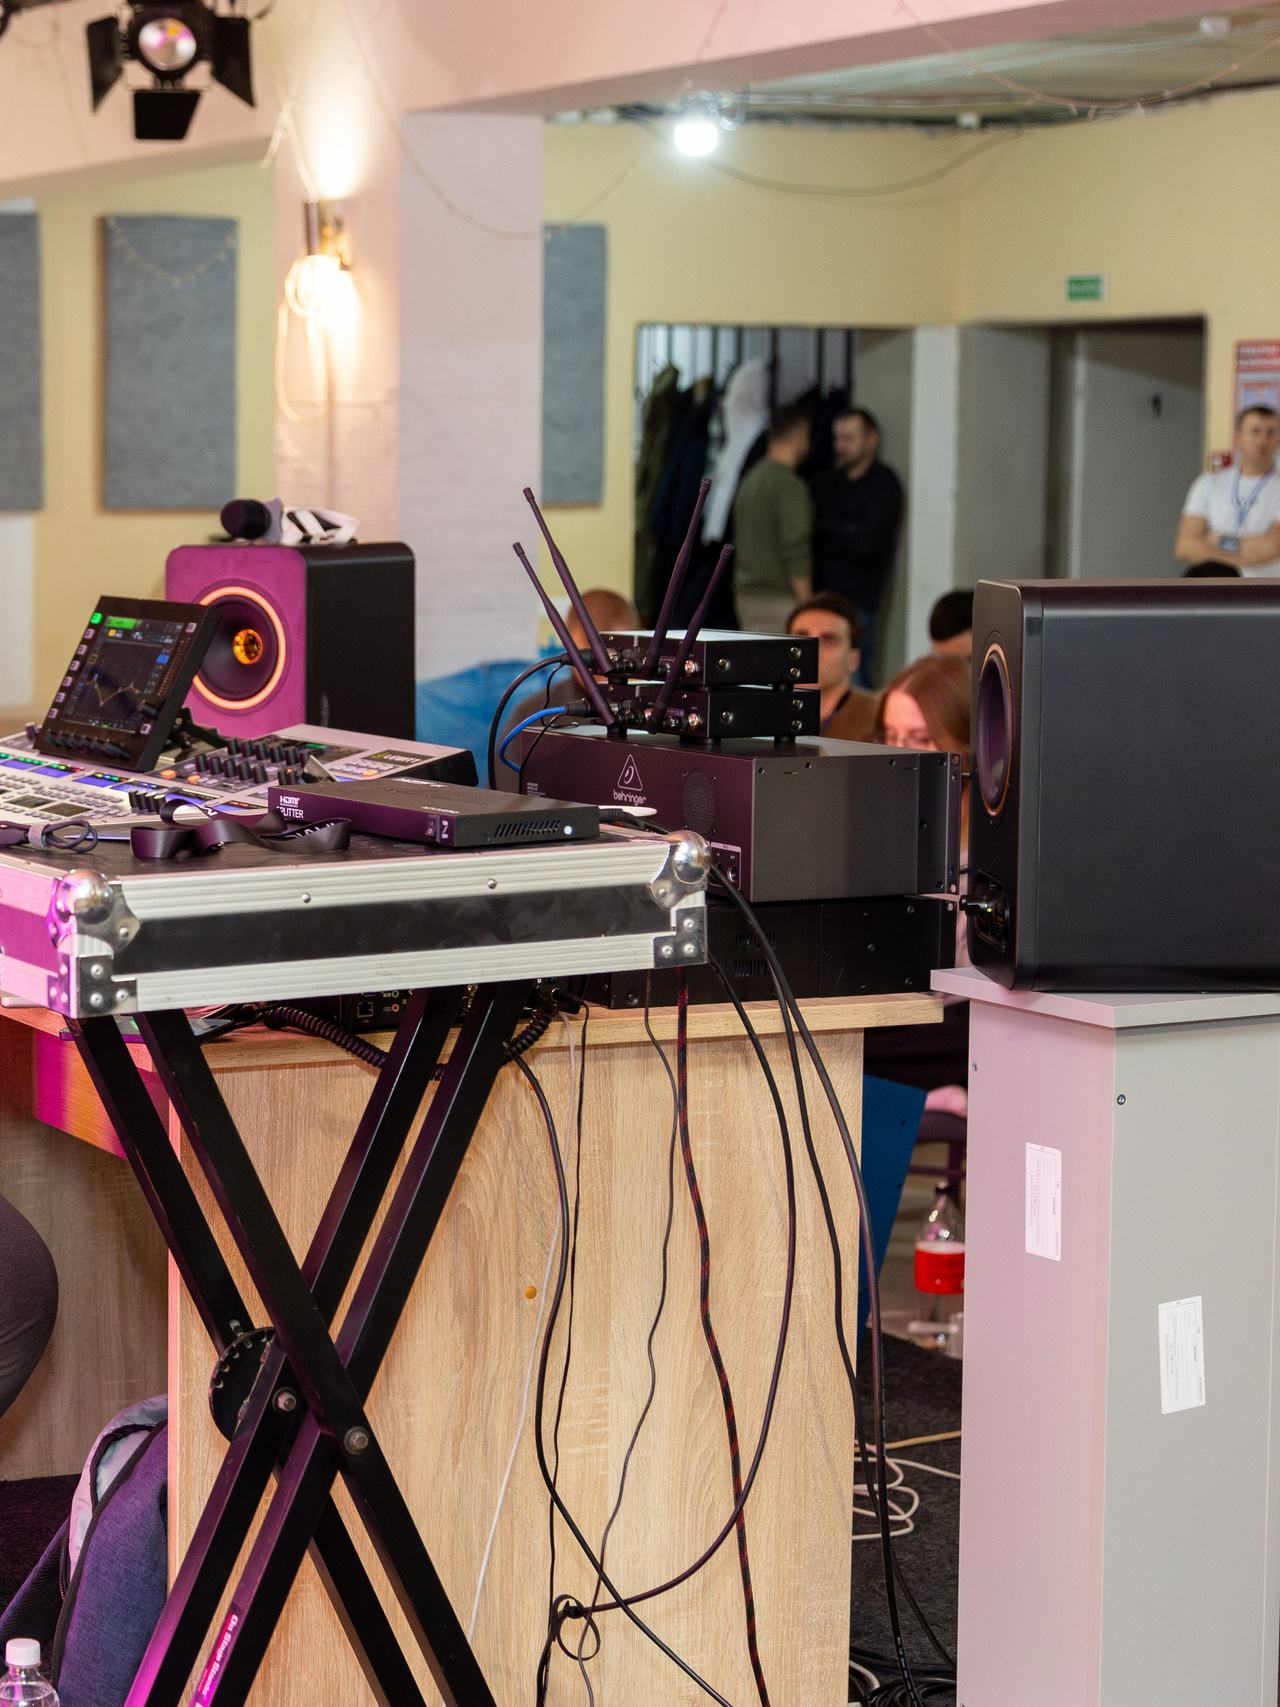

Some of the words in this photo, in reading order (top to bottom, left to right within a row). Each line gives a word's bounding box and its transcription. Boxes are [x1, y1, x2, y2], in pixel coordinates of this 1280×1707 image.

[279, 795, 300, 805] HDMI
[613, 789, 647, 806] behringer
[276, 806, 304, 819] PLITTER
[215, 1632, 231, 1662] Stage
[202, 1661, 220, 1696] Stands
